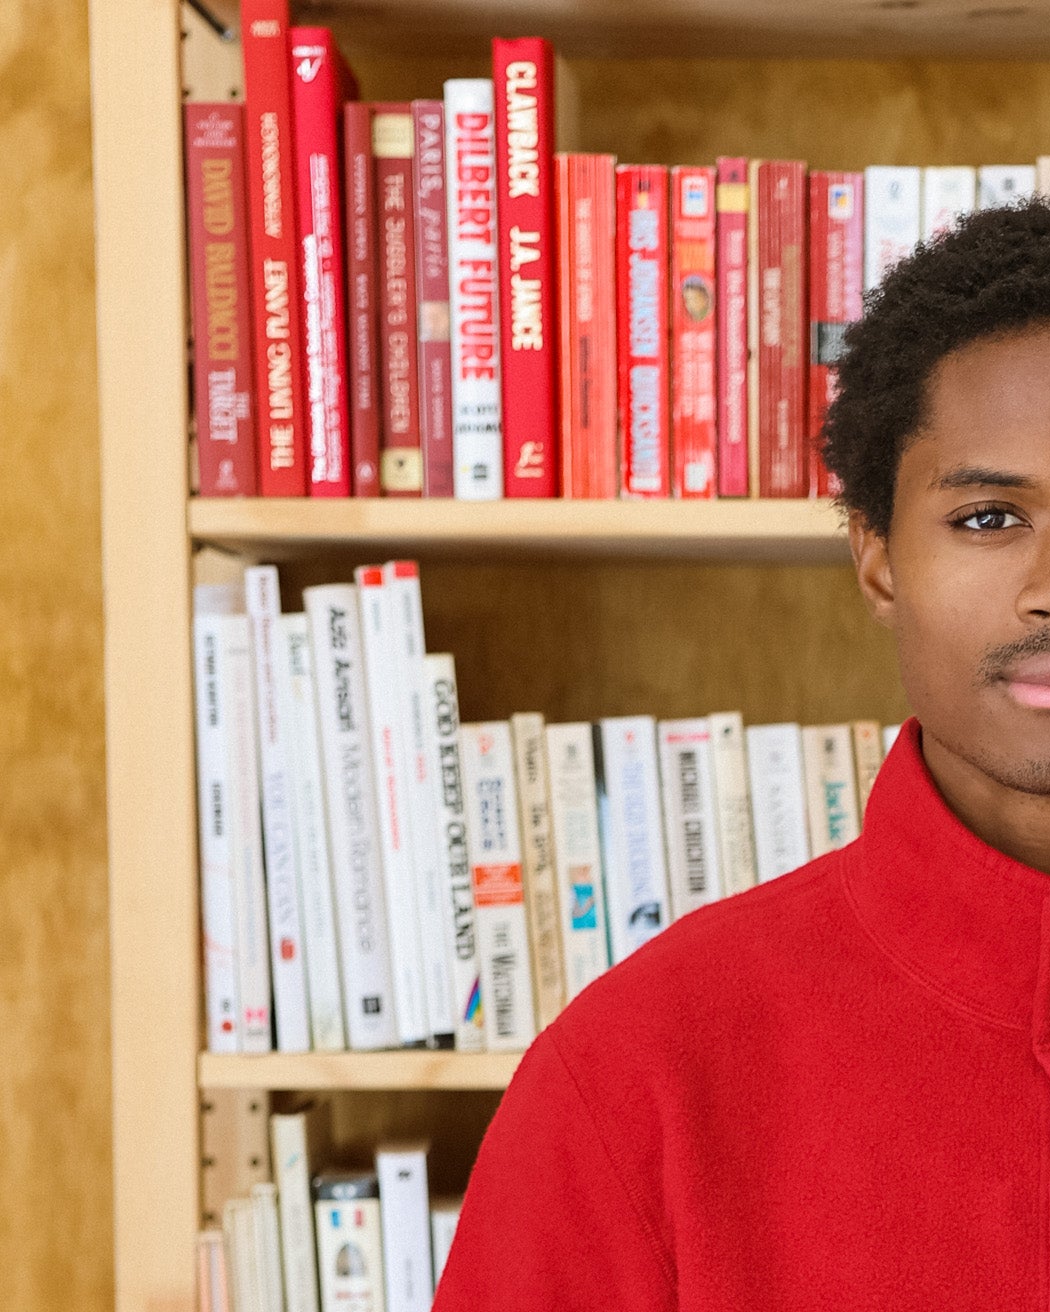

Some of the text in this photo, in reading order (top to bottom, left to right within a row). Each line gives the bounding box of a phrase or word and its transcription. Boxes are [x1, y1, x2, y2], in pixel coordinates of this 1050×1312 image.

[455, 112, 492, 247] DILBERT
[505, 60, 541, 199] CLAWBACK
[201, 157, 234, 236] DAVID
[459, 258, 496, 381] FUTURE
[510, 272, 543, 351] JANCE
[269, 423, 295, 470] THE
[335, 659, 356, 733] Ansari
[433, 678, 476, 961] GOD KEEP OUR LAND
